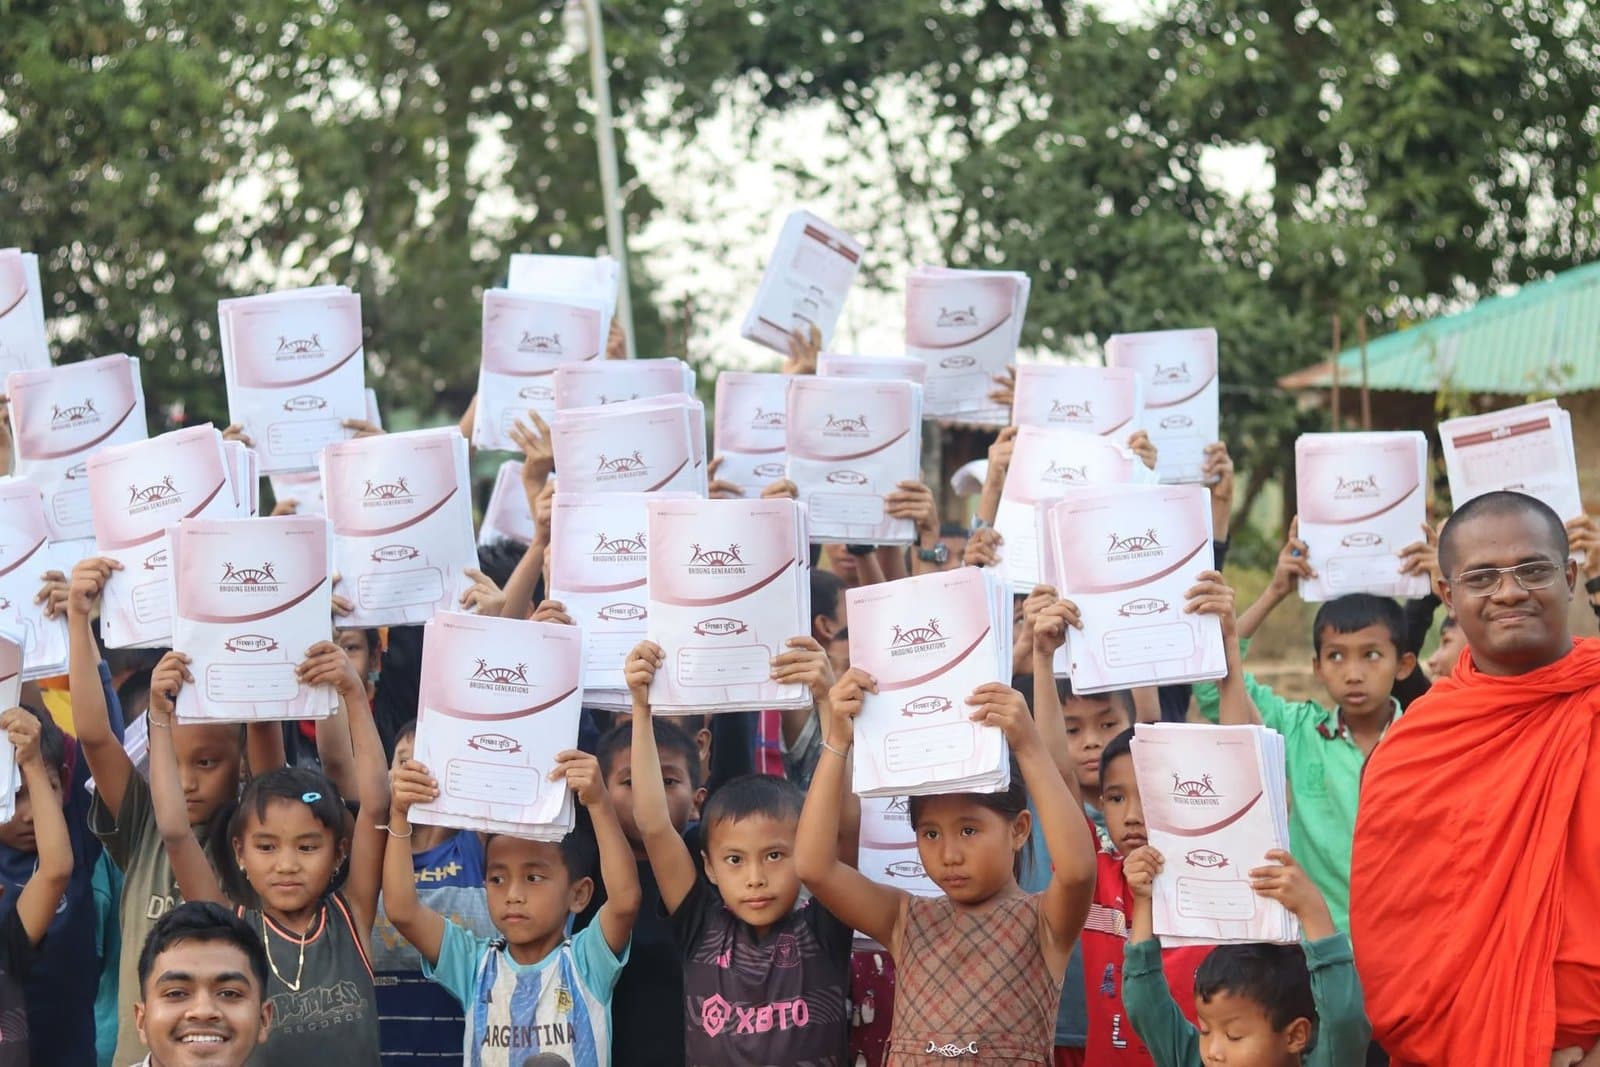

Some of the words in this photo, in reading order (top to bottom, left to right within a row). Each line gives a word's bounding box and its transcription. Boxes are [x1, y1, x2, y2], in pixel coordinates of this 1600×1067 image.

[150, 497, 182, 510] GENERATIONS
[592, 554, 616, 562] BRIDGING
[617, 554, 647, 562] GENERATION
[1107, 553, 1130, 563] BRIDGING
[1131, 550, 1163, 560] GENERATIONS
[688, 567, 711, 575] BRIDGING
[711, 567, 746, 575] GENERATIONS
[219, 585, 243, 593] BRIDGING
[244, 585, 279, 593] GENERATIONS
[891, 647, 914, 657] BRIDGING
[914, 641, 946, 654] GENERATIONS
[469, 682, 494, 691] BRIDGING
[494, 684, 529, 695] GENERATIONS
[1189, 798, 1220, 806] GENERATIONS
[736, 999, 809, 1034] XBTO
[481, 1023, 577, 1049] ARGENTINA
